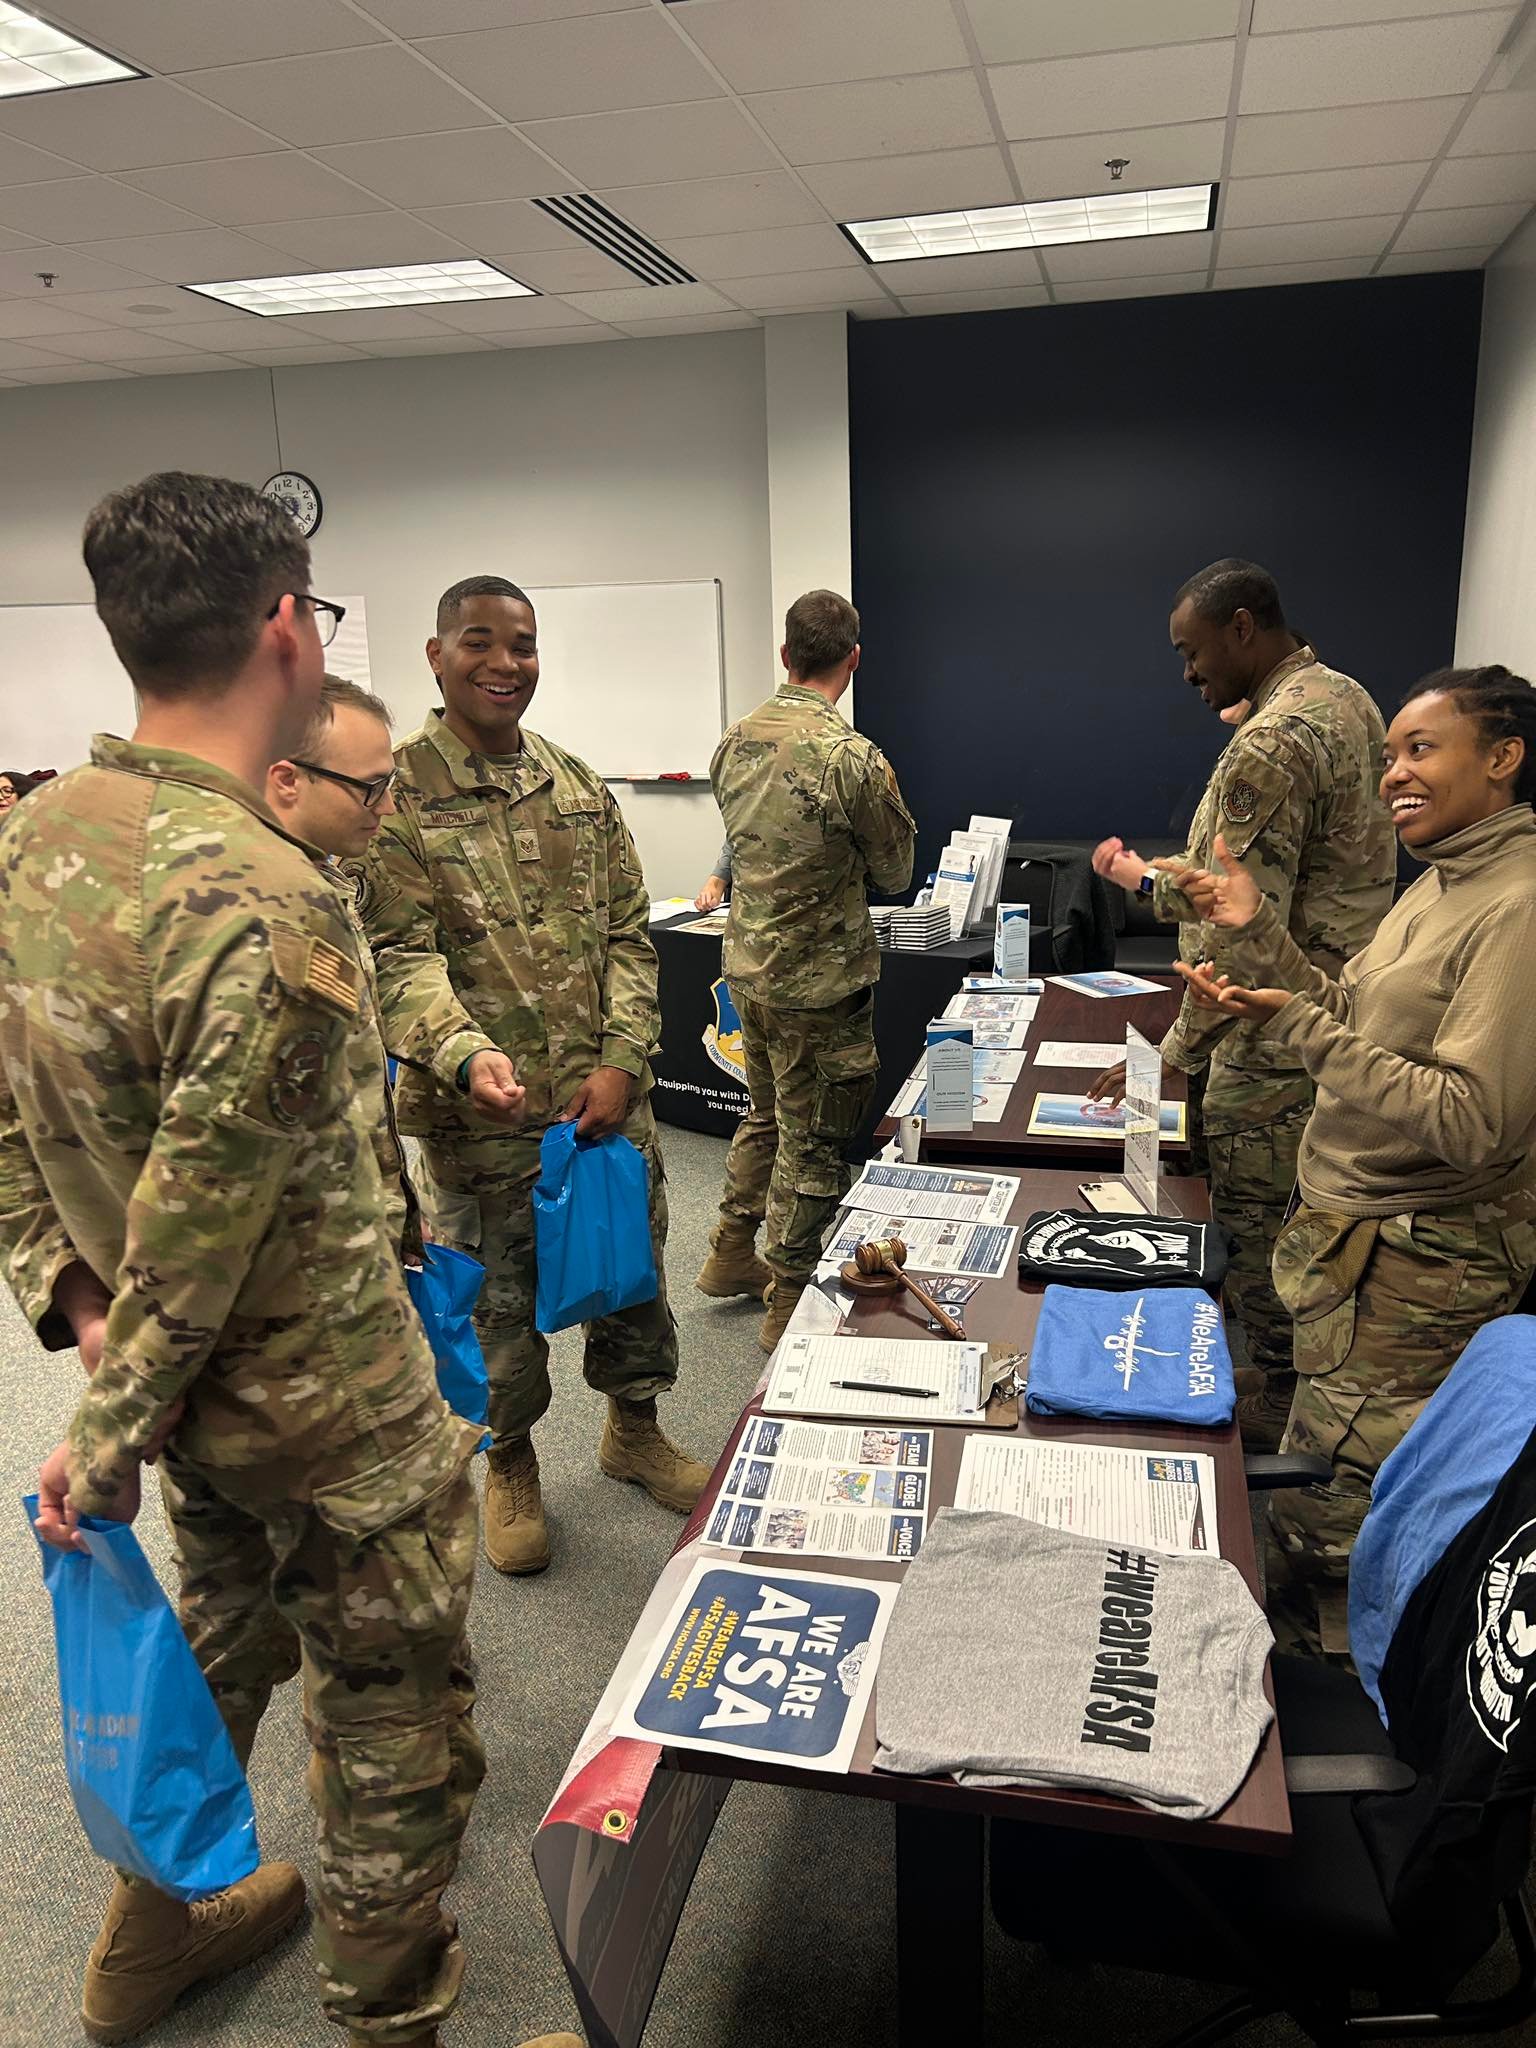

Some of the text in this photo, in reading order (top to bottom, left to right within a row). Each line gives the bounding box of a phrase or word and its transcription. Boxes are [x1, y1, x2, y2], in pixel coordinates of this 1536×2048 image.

[274, 484, 281, 492] 11
[283, 479, 292, 488] 12
[296, 482, 300, 490] 1
[302, 490, 309, 498] 2
[305, 514, 312, 522] 4
[307, 502, 314, 510] 3
[657, 1078, 700, 1094] Equipping
[701, 1088, 718, 1098] you
[720, 1090, 741, 1101] with
[707, 1100, 749, 1114] you need
[1188, 1302, 1220, 1397] #WeAreAFSA
[906, 1444, 920, 1465] TEAM
[902, 1475, 917, 1506] GLOBE
[898, 1527, 914, 1555] VOICE
[1487, 1560, 1510, 1599] YOU
[660, 1608, 702, 1680] WWW.HQAFSA.ORG
[667, 1595, 726, 1702] #AFSAGIVESBACK
[693, 1611, 740, 1690] #WEAREAFSA
[699, 1584, 811, 1729] AFSA
[778, 1615, 846, 1720] WE ARE
